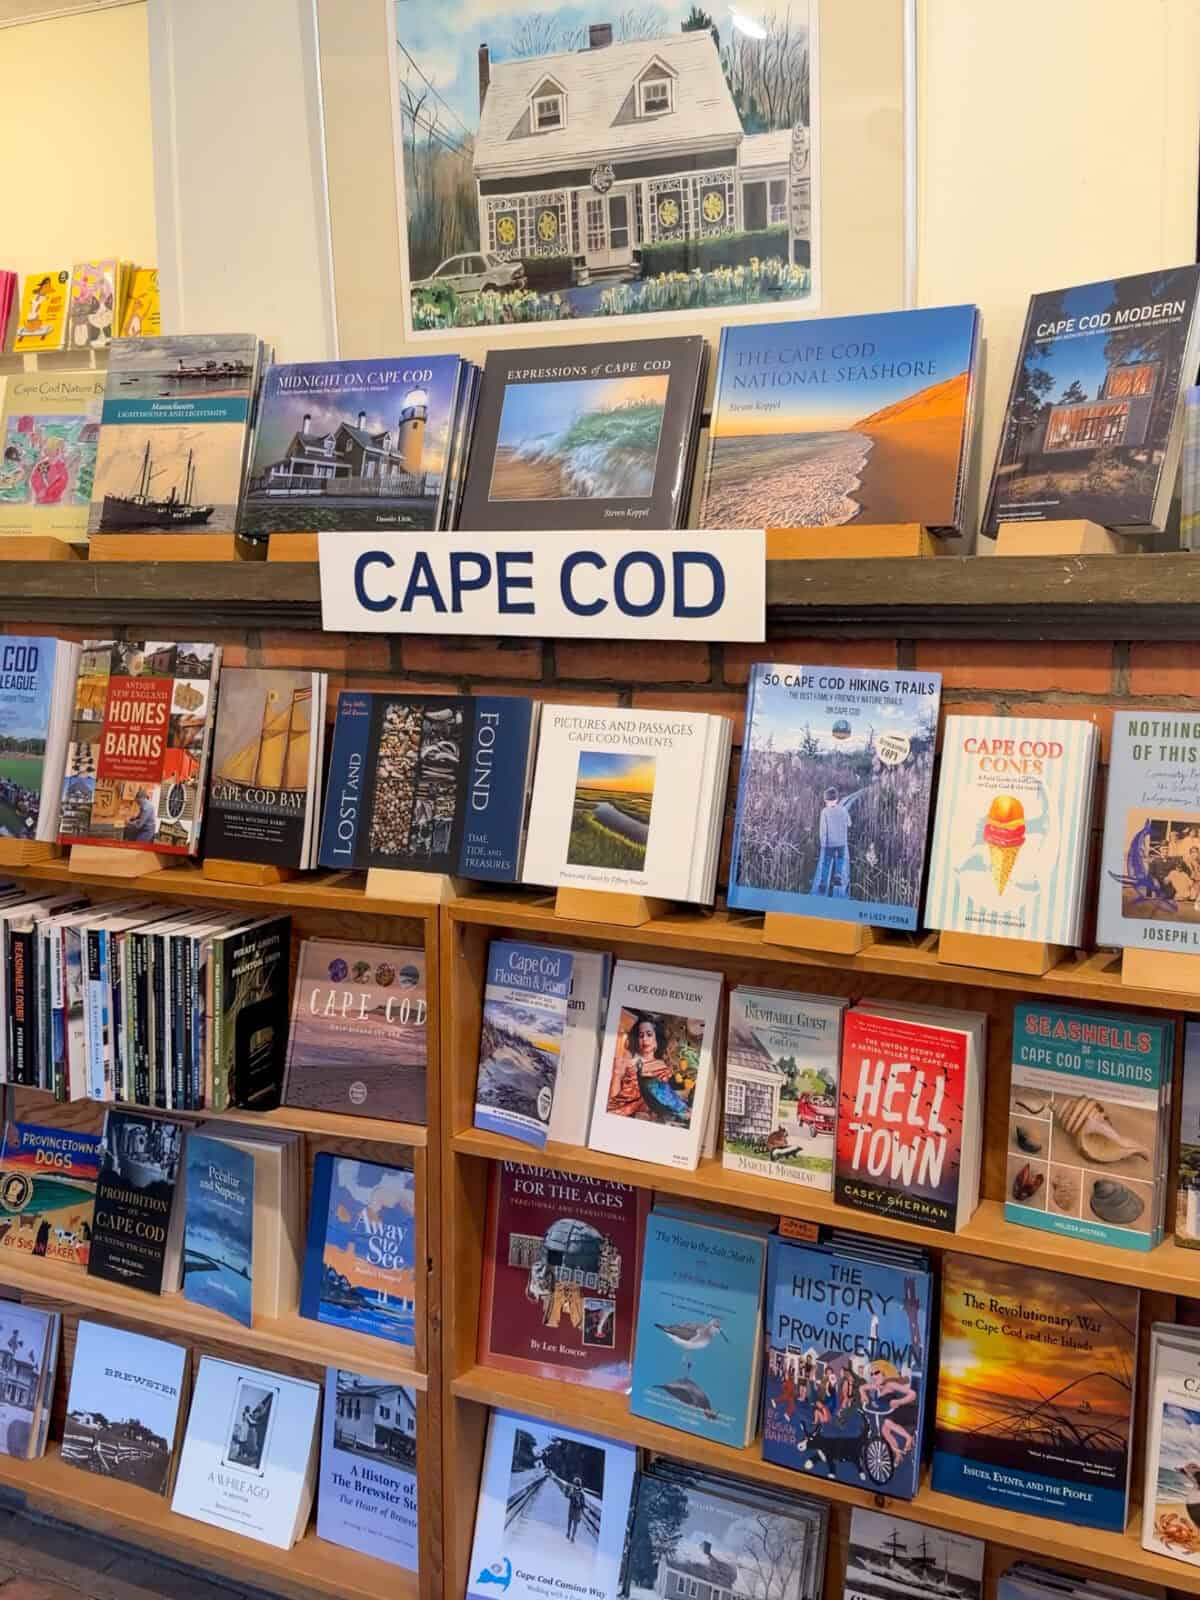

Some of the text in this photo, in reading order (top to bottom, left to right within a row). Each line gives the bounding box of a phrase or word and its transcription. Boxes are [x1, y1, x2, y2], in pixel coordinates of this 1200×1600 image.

[1037, 300, 1186, 337] CAPE COD MODERN
[736, 342, 875, 367] THE CAPE COD
[278, 369, 433, 388] MIDNIGHT ON CAPE COD
[507, 365, 587, 380] EXPRESSIONS
[605, 362, 638, 374] CAPE
[643, 359, 672, 371] COD
[733, 360, 936, 389] NATIONAL SEASHORE
[353, 550, 726, 618] CAPE COD
[2, 646, 39, 672] COD
[763, 674, 935, 696] 50 CAPE COD HIKING TRAILS
[109, 701, 166, 725] HOMES
[553, 716, 694, 736] PICTURES AND PASSAGES
[568, 731, 673, 747] CAPE COD MOMENTS
[1128, 720, 1200, 738] NOTHING
[104, 732, 163, 758] BARNS
[964, 738, 1063, 758] CAPE COD
[1133, 744, 1197, 762] OF THIS
[472, 712, 500, 811] FOUND
[979, 757, 1043, 775] CONES
[212, 785, 304, 808] CAPE COD BAY
[333, 752, 362, 855] LOST AND
[464, 858, 511, 871] TREASURES
[1143, 927, 1188, 944] JOSEPH
[14, 940, 25, 993] REASONABLE
[509, 951, 561, 977] Cape Cod
[495, 968, 532, 987] Flotsam
[533, 976, 540, 989] &
[627, 984, 704, 1002] CAPE COD REVIEW
[310, 988, 428, 1026] CAPE COD
[745, 1000, 828, 1031] INEVITABLE GUEST
[1025, 1013, 1152, 1054] SEASHELLS
[880, 1041, 909, 1051] UNTOLD
[910, 1046, 933, 1056] STORY
[923, 1057, 941, 1066] CAPE
[943, 1062, 960, 1070] COD
[1021, 1046, 1053, 1064] CAPE
[1057, 1052, 1080, 1069] COD
[1097, 1059, 1152, 1082] ISLANDS
[854, 1058, 948, 1134] HELL
[23, 1132, 94, 1153] PROVINCETOWN
[848, 1122, 947, 1189] TOWN
[35, 1149, 72, 1169] DOGS
[100, 1185, 168, 1212] PROHIBITION
[514, 1179, 623, 1208] FOR THE AGES
[844, 1184, 948, 1218] CASEY SHERMAN
[96, 1211, 165, 1242] CAPE COD
[352, 1208, 408, 1243] Away
[4, 1235, 15, 1245] BY
[47, 1246, 74, 1258] BAKER
[367, 1236, 405, 1270] See
[383, 1237, 399, 1254] to
[829, 1264, 863, 1285] THE
[792, 1275, 894, 1315] HISTORY
[826, 1312, 851, 1328] OF
[963, 1292, 1102, 1332] The Revolutionary War
[779, 1315, 922, 1368] PROVINCETOWN
[962, 1319, 1093, 1350] on Cape Cod and the Islands
[530, 1339, 587, 1358] By Lee Roscoe
[104, 1367, 177, 1396] BREWSTER
[208, 1471, 215, 1482] A
[217, 1473, 246, 1493] WHILE
[247, 1481, 270, 1499] AGO
[331, 1472, 351, 1488] The
[354, 1479, 401, 1504] Brewster
[350, 1465, 414, 1495] A History of
[1026, 1481, 1043, 1492] AND
[1045, 1484, 1061, 1496] THE
[1062, 1486, 1093, 1502] PEOPLE
[338, 1494, 390, 1519] The Heart of
[515, 1569, 608, 1600] Cape Cod Camino Way
